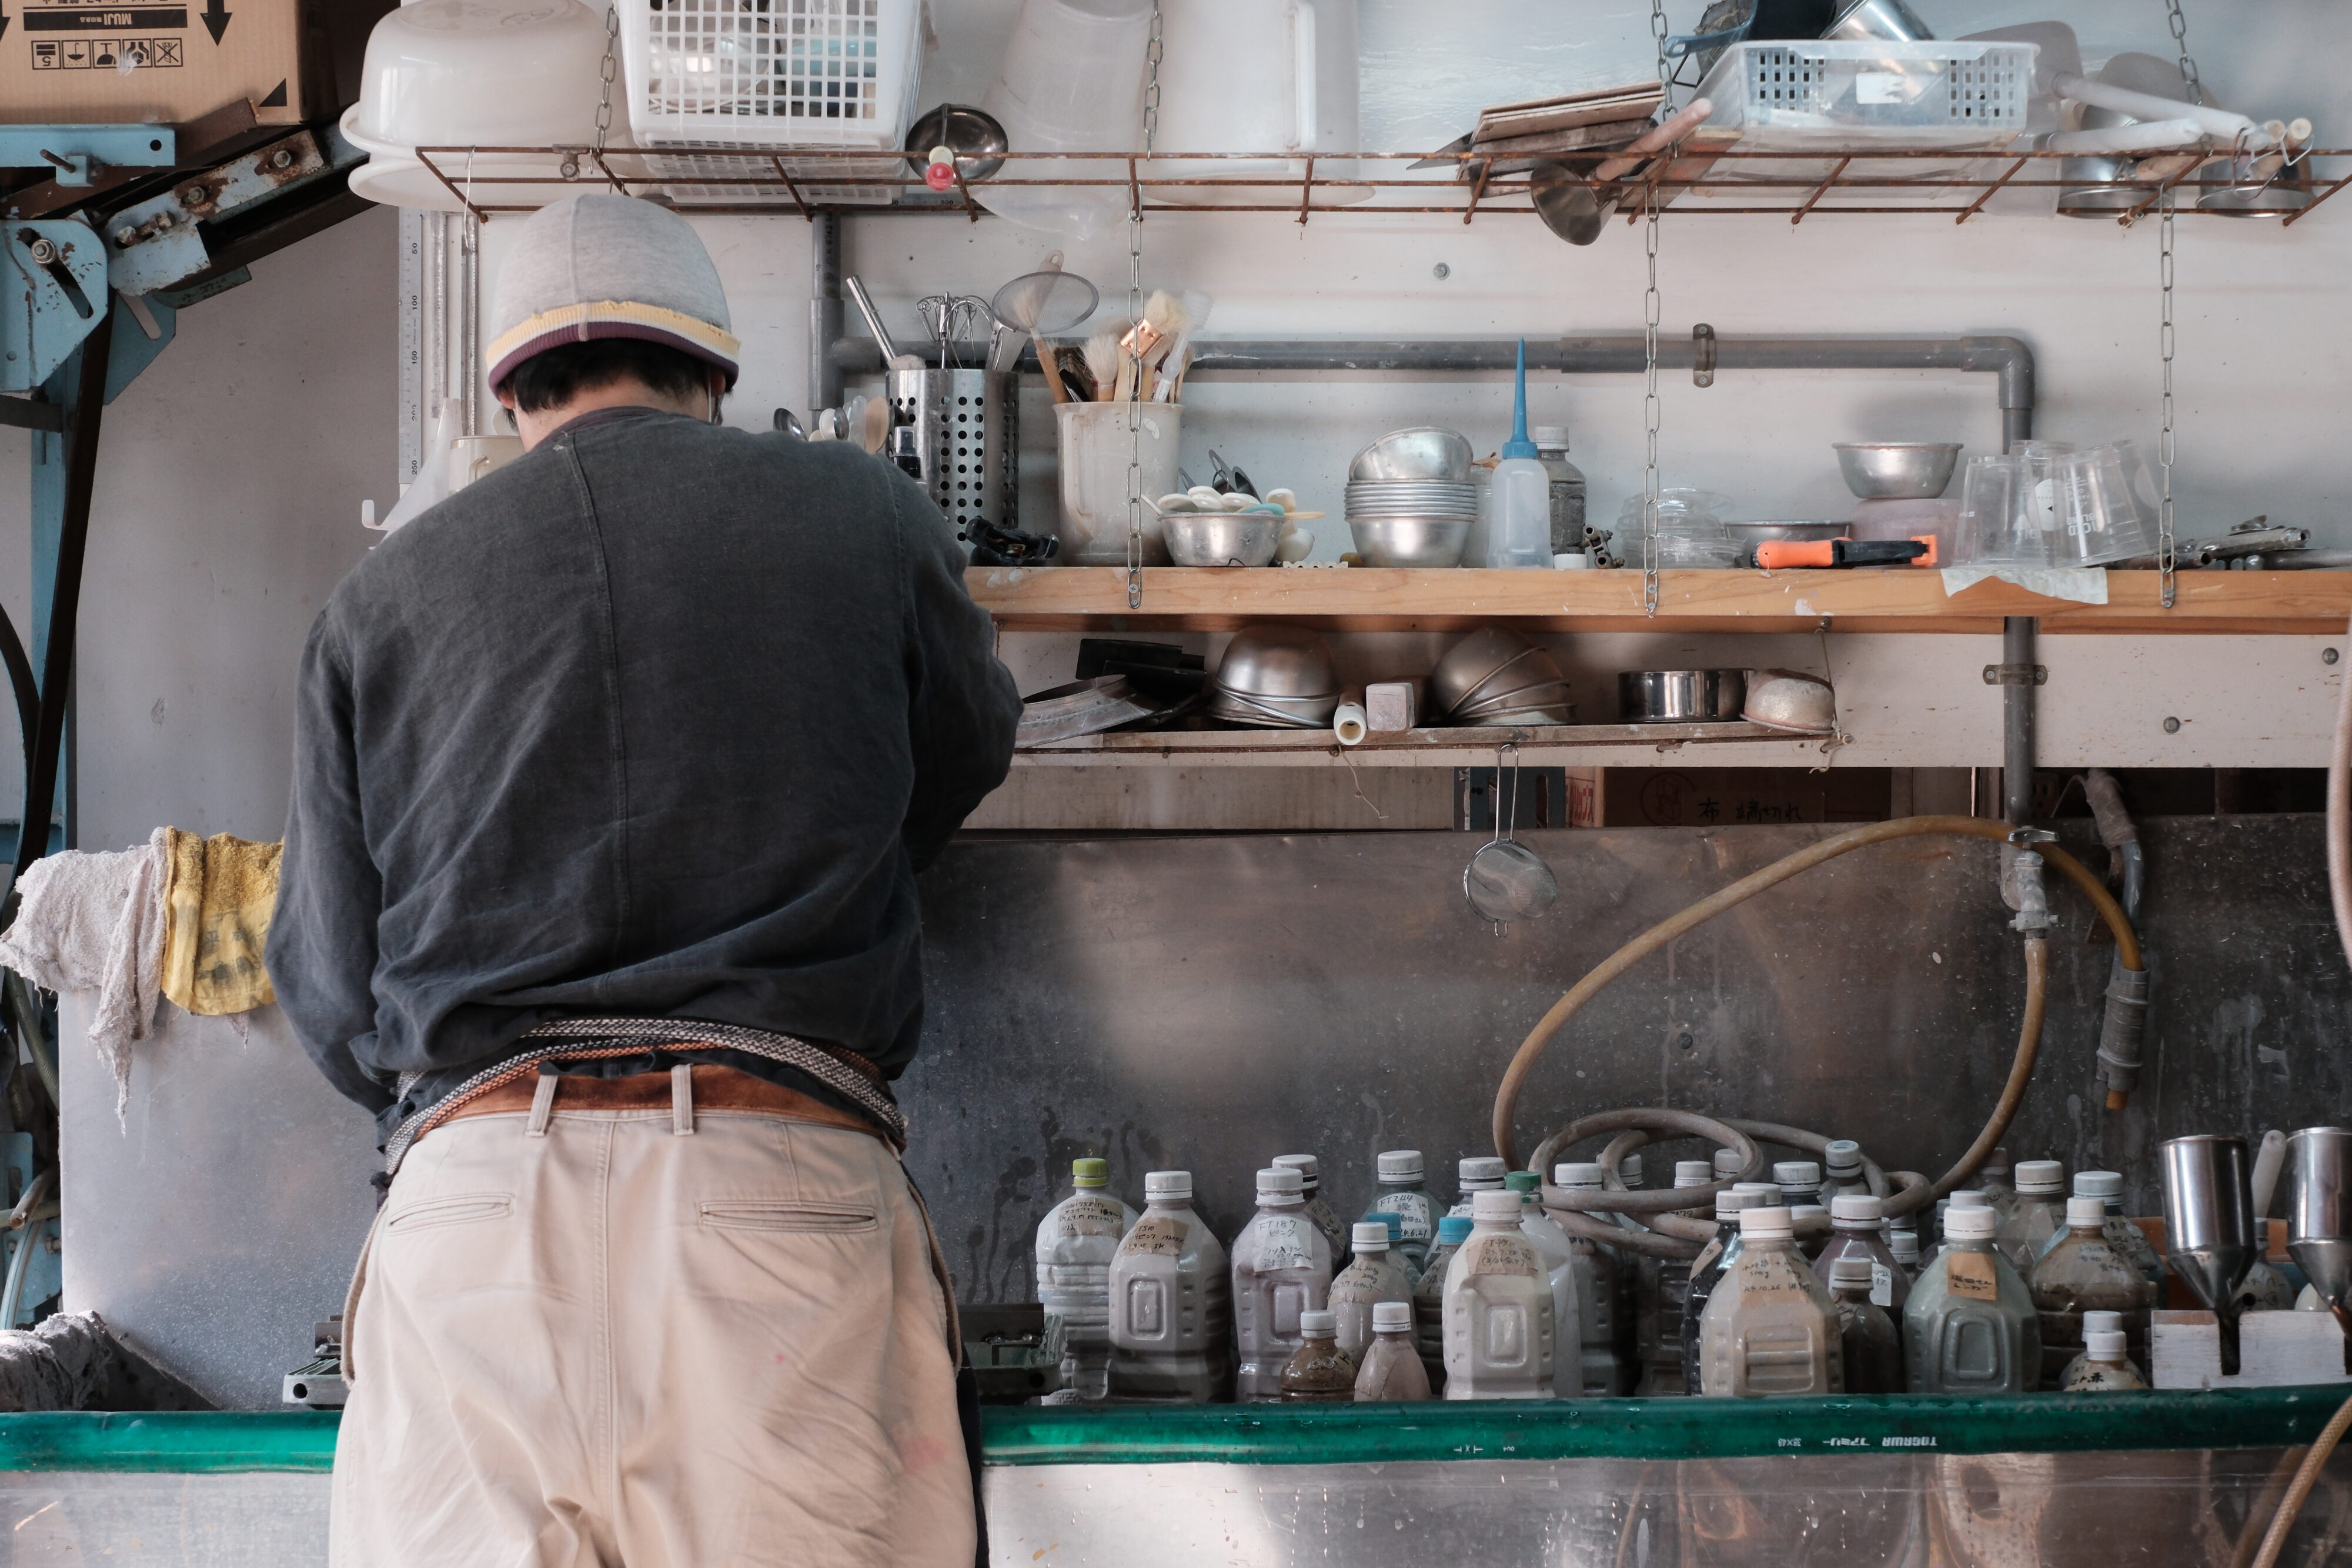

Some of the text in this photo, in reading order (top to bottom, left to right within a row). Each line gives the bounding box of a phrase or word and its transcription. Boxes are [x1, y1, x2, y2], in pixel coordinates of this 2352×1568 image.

[103, 13, 132, 25] MUJI
[42, 56, 51, 66] 5
[412, 243, 417, 254] 50
[2066, 513, 2094, 526] BLND
[2069, 521, 2097, 536] ICD
[1698, 797, 1719, 823] 布
[1258, 1219, 1297, 1231] FT187
[1823, 1437, 1870, 1446] ファミリー
[1882, 1436, 1937, 1447] TOGAWA
